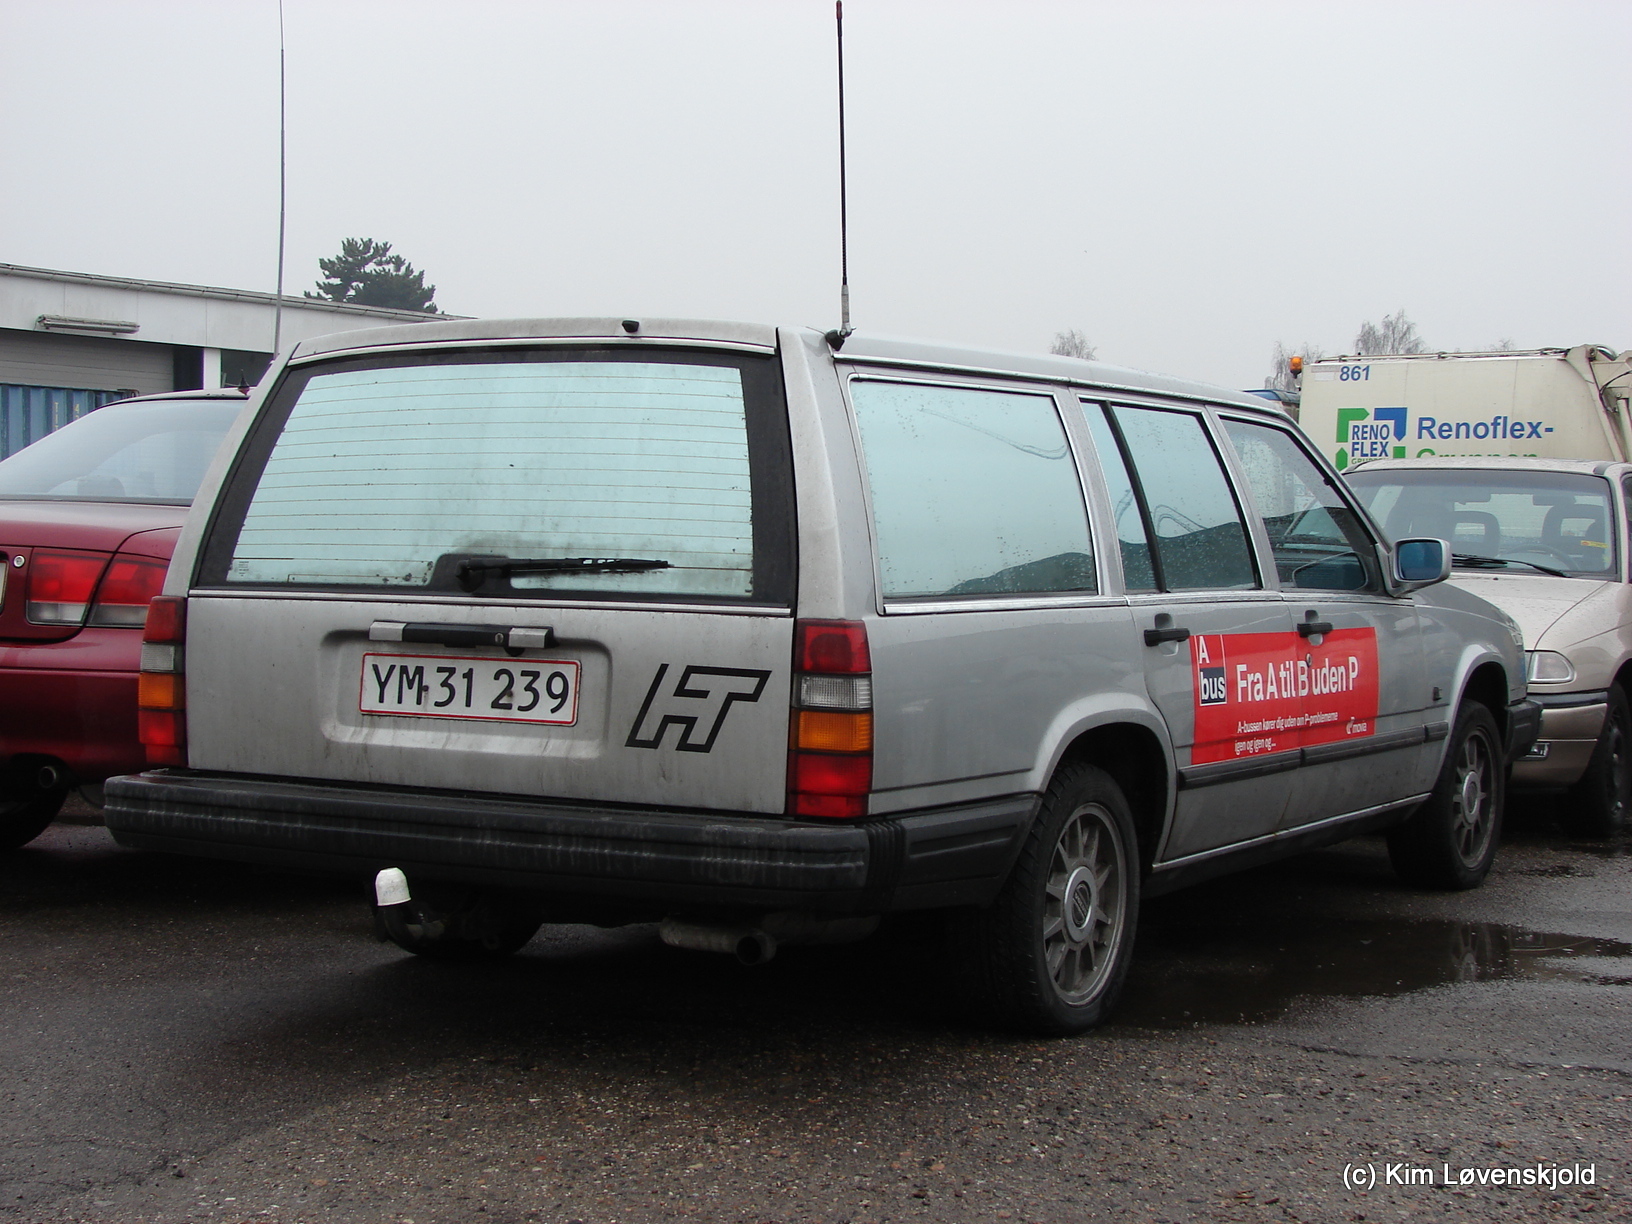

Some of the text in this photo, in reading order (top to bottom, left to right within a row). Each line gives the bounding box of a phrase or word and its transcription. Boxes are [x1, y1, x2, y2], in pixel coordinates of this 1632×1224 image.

[1339, 365, 1370, 382] 861
[1351, 424, 1390, 441] RENO
[1417, 416, 1554, 440] Renoflex-
[1351, 442, 1389, 458] FLEX
[1199, 636, 1210, 664] A
[372, 664, 570, 714] YM 31 239
[1200, 671, 1226, 700] bus
[1236, 656, 1359, 702] Fra A til B uden P
[1276, 716, 1284, 731] dig
[1284, 715, 1296, 728] uden
[1234, 739, 1246, 755] igen
[1246, 739, 1254, 753] og
[1253, 738, 1265, 752] igen
